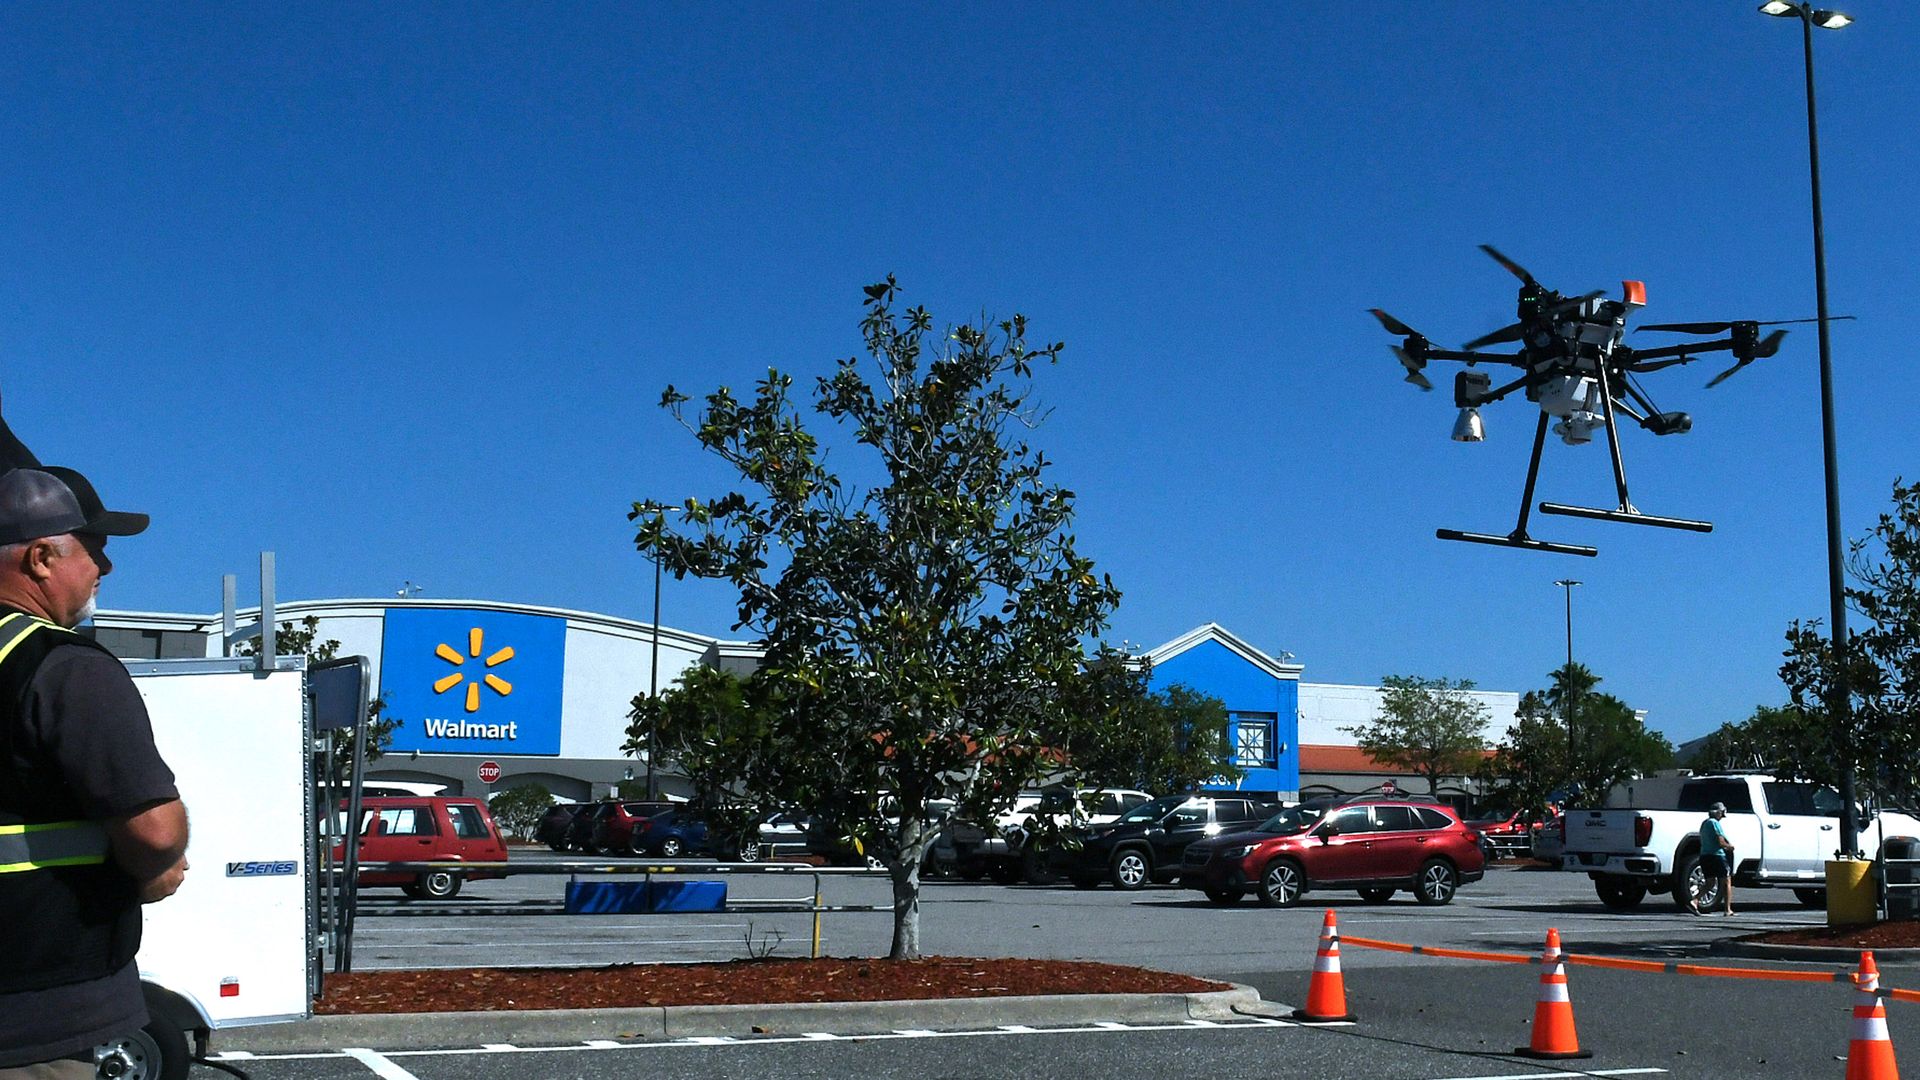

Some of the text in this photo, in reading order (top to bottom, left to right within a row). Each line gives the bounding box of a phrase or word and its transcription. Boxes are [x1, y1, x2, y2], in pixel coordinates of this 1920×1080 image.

[425, 718, 517, 739] Walmart
[480, 767, 499, 776] STOP
[228, 862, 294, 875] V-Series
